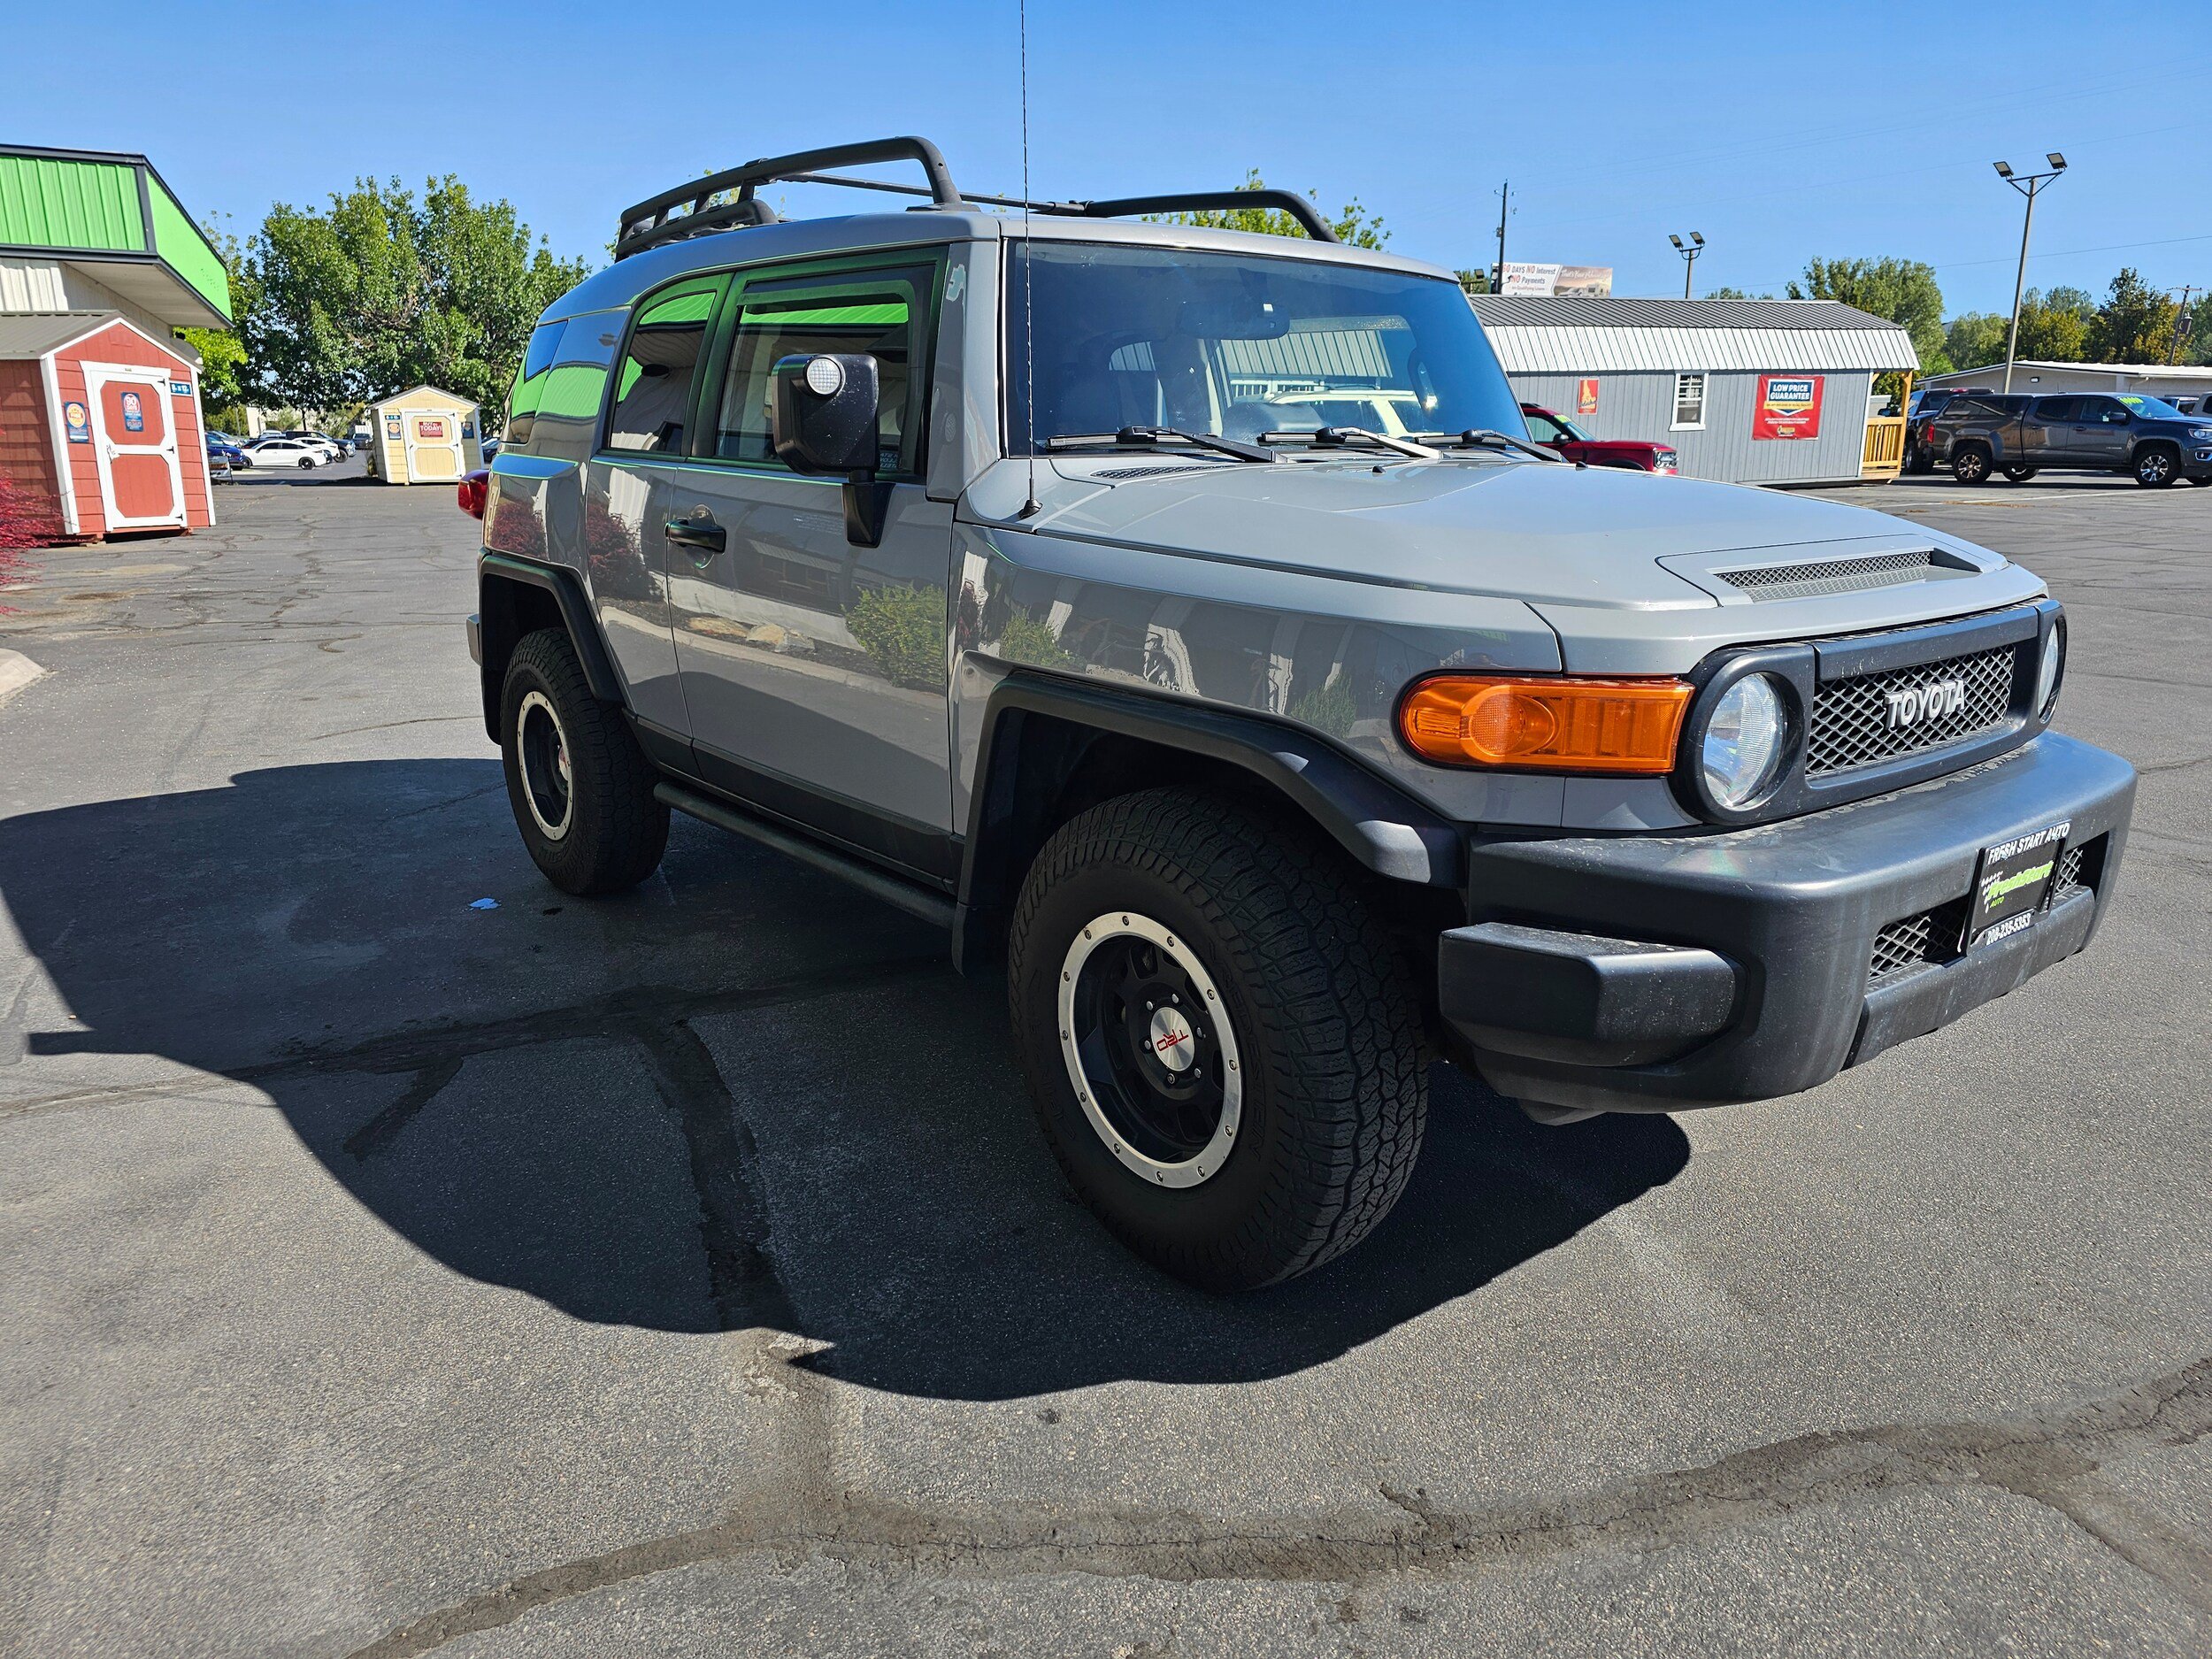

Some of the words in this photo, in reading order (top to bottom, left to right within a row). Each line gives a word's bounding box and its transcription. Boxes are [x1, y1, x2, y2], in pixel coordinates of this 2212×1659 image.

[1526, 265, 1536, 273] NO
[1536, 266, 1556, 275] Interest
[1522, 276, 1546, 285] Payments
[1884, 678, 1964, 728] TOYOTA
[1987, 841, 2017, 864] FRESH
[2017, 830, 2047, 853] START
[2045, 823, 2070, 842] AUTO
[1990, 895, 2004, 908] AUTO
[1156, 1028, 1189, 1052] TRD
